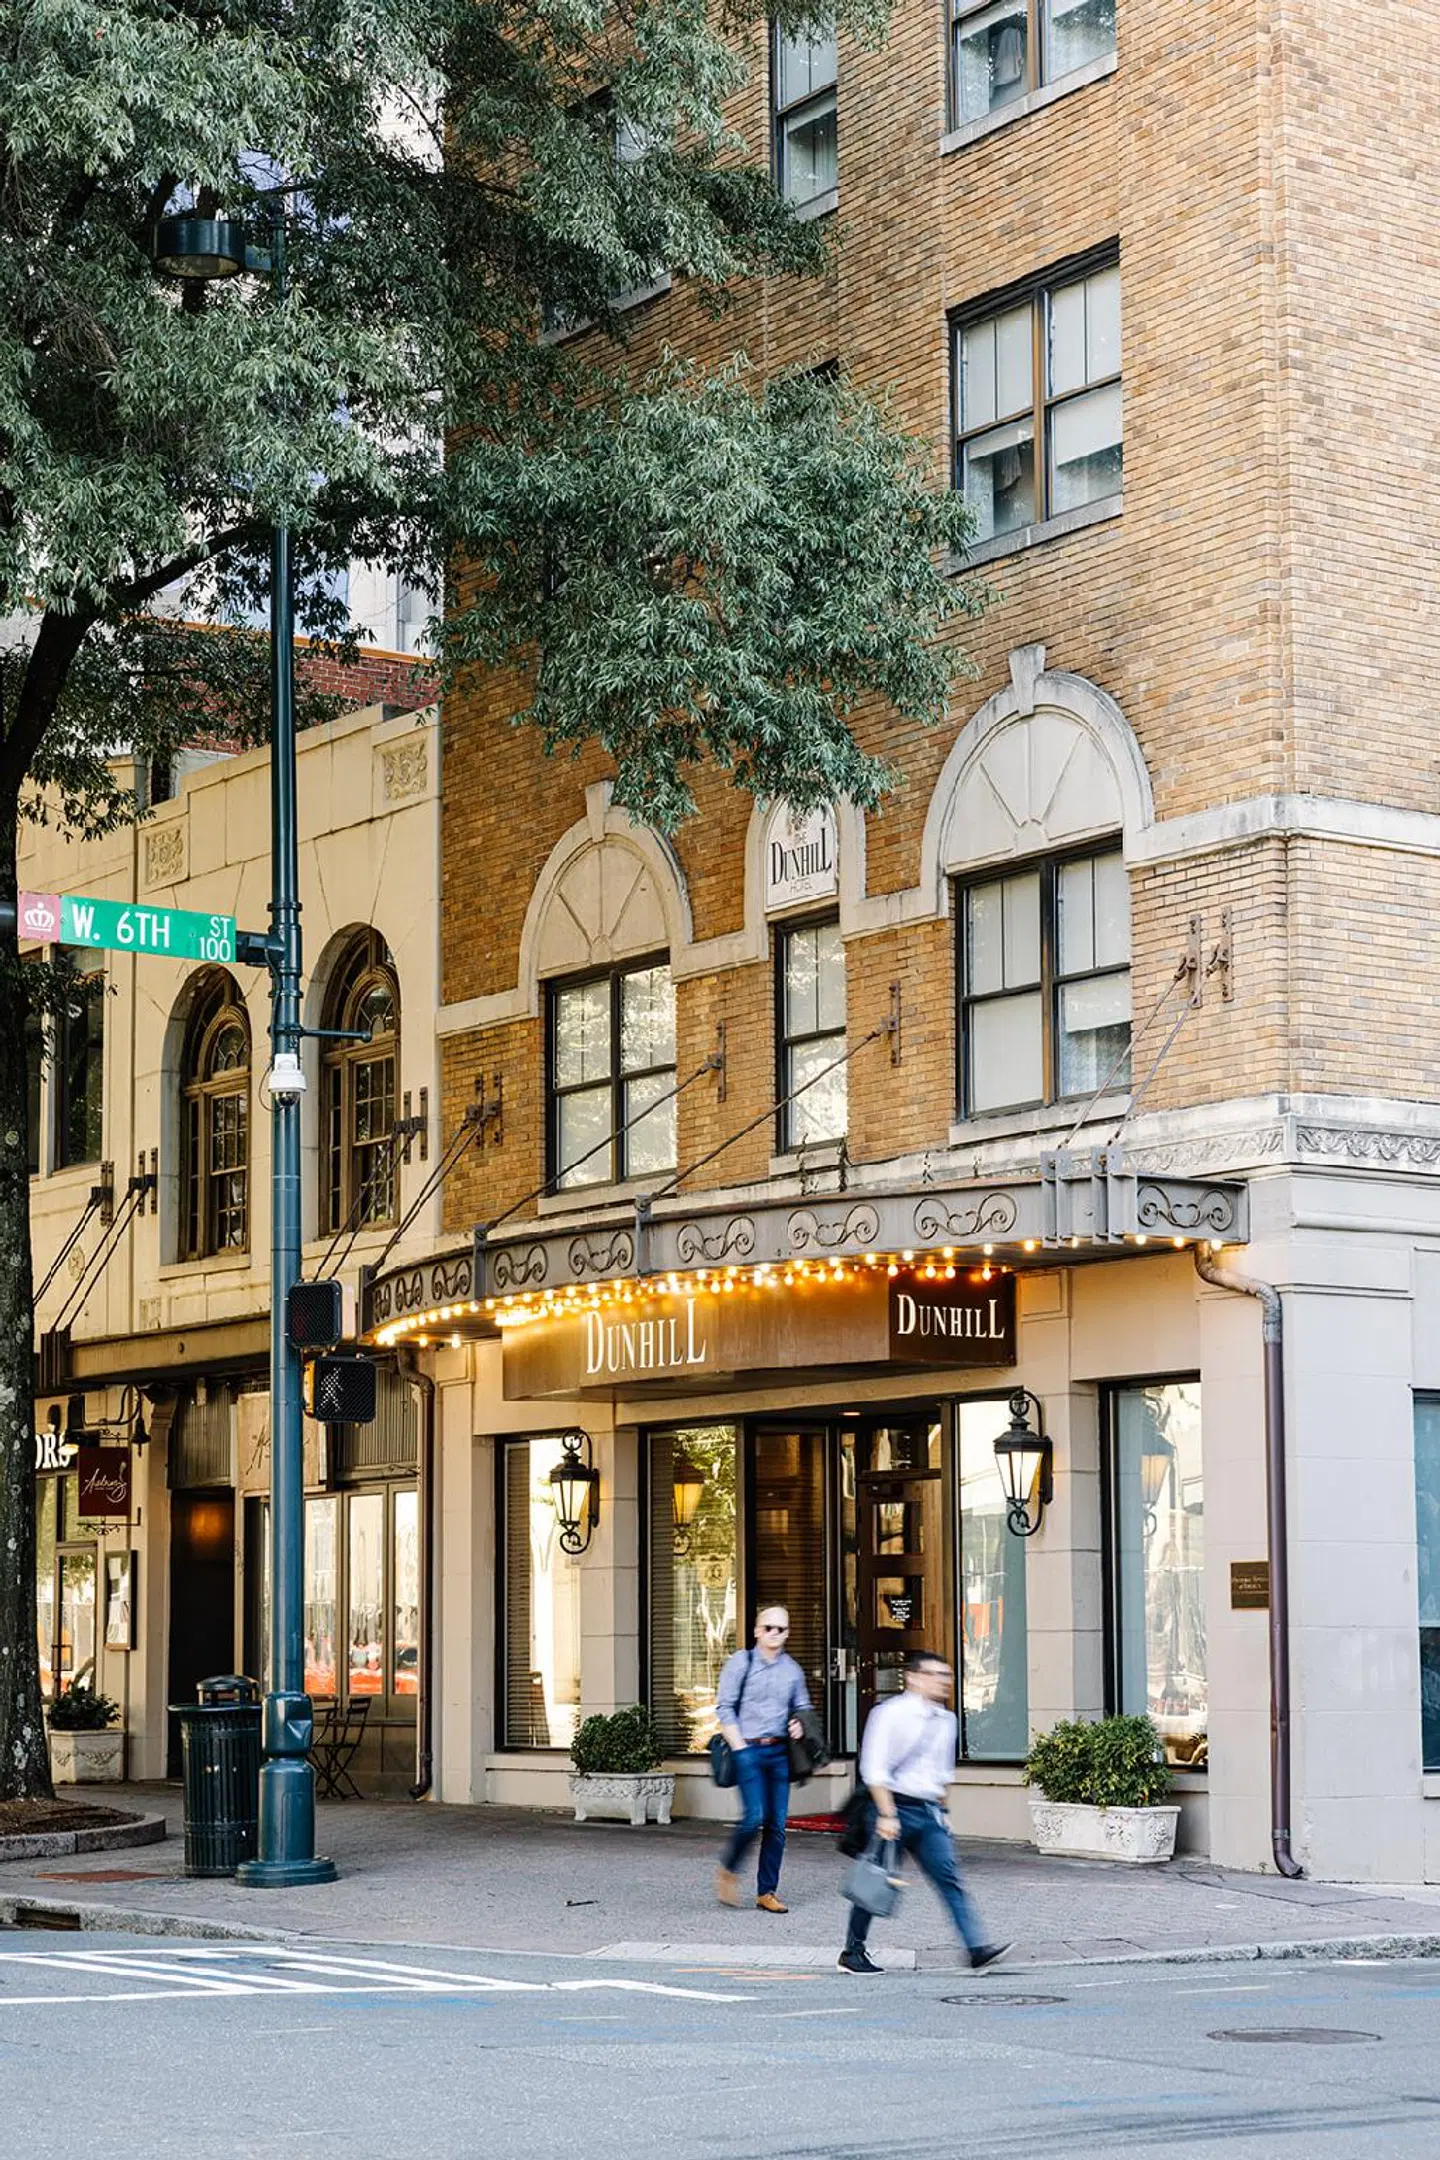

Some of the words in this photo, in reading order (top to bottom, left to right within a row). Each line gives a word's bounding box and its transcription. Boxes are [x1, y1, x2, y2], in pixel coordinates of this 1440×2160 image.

[770, 828, 832, 886] DUNHILL
[71, 903, 100, 941] W.
[116, 910, 171, 948] 6TH
[210, 915, 231, 938] ST
[200, 936, 231, 961] 100
[586, 1298, 706, 1374] DUNHILL
[896, 1294, 1005, 1339] DUNHILL
